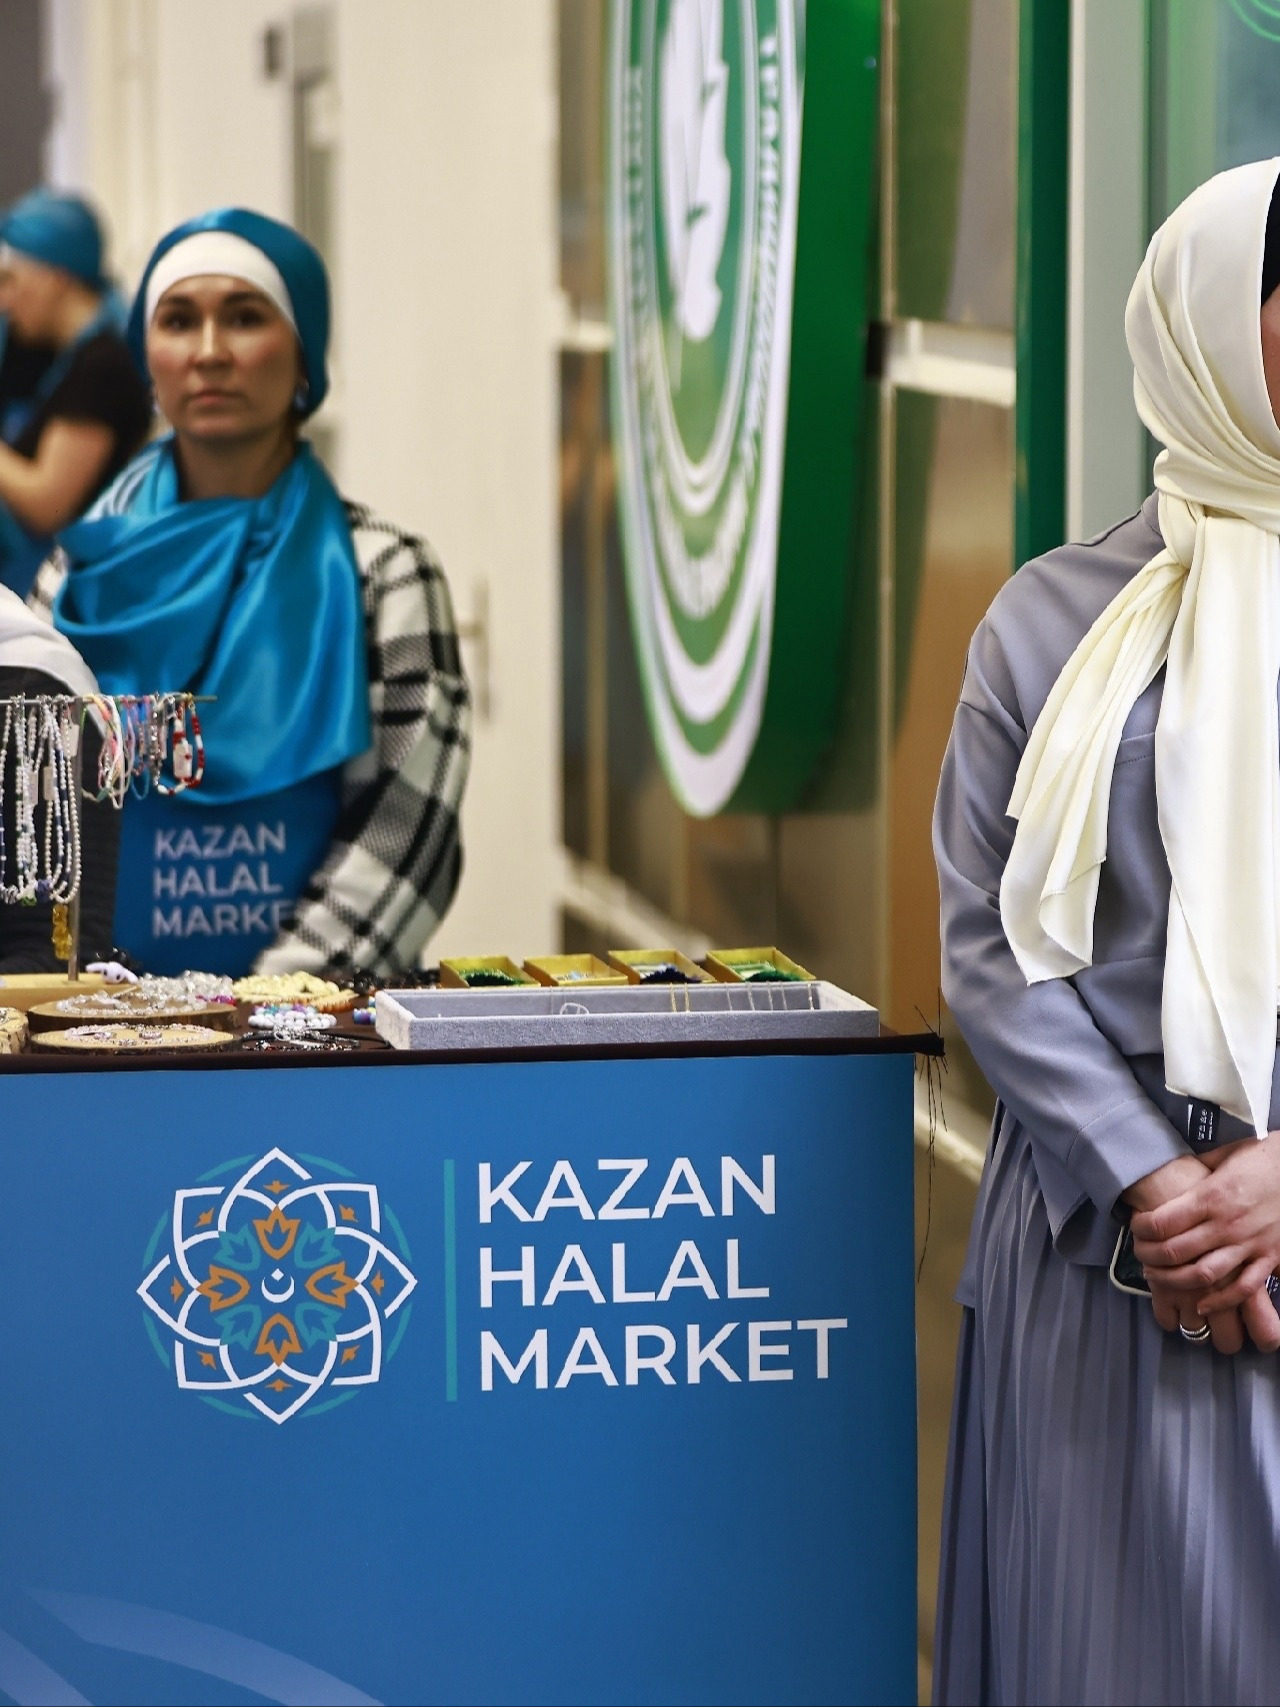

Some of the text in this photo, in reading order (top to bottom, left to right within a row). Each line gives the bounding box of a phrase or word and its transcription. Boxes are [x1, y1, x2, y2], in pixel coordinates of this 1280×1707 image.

[153, 821, 287, 860] KAZAN
[153, 862, 283, 898] HALAL
[153, 900, 294, 937] MARKE
[478, 1154, 776, 1224] KAZAN
[479, 1238, 770, 1308] HALAL
[480, 1317, 848, 1392] MARKET
